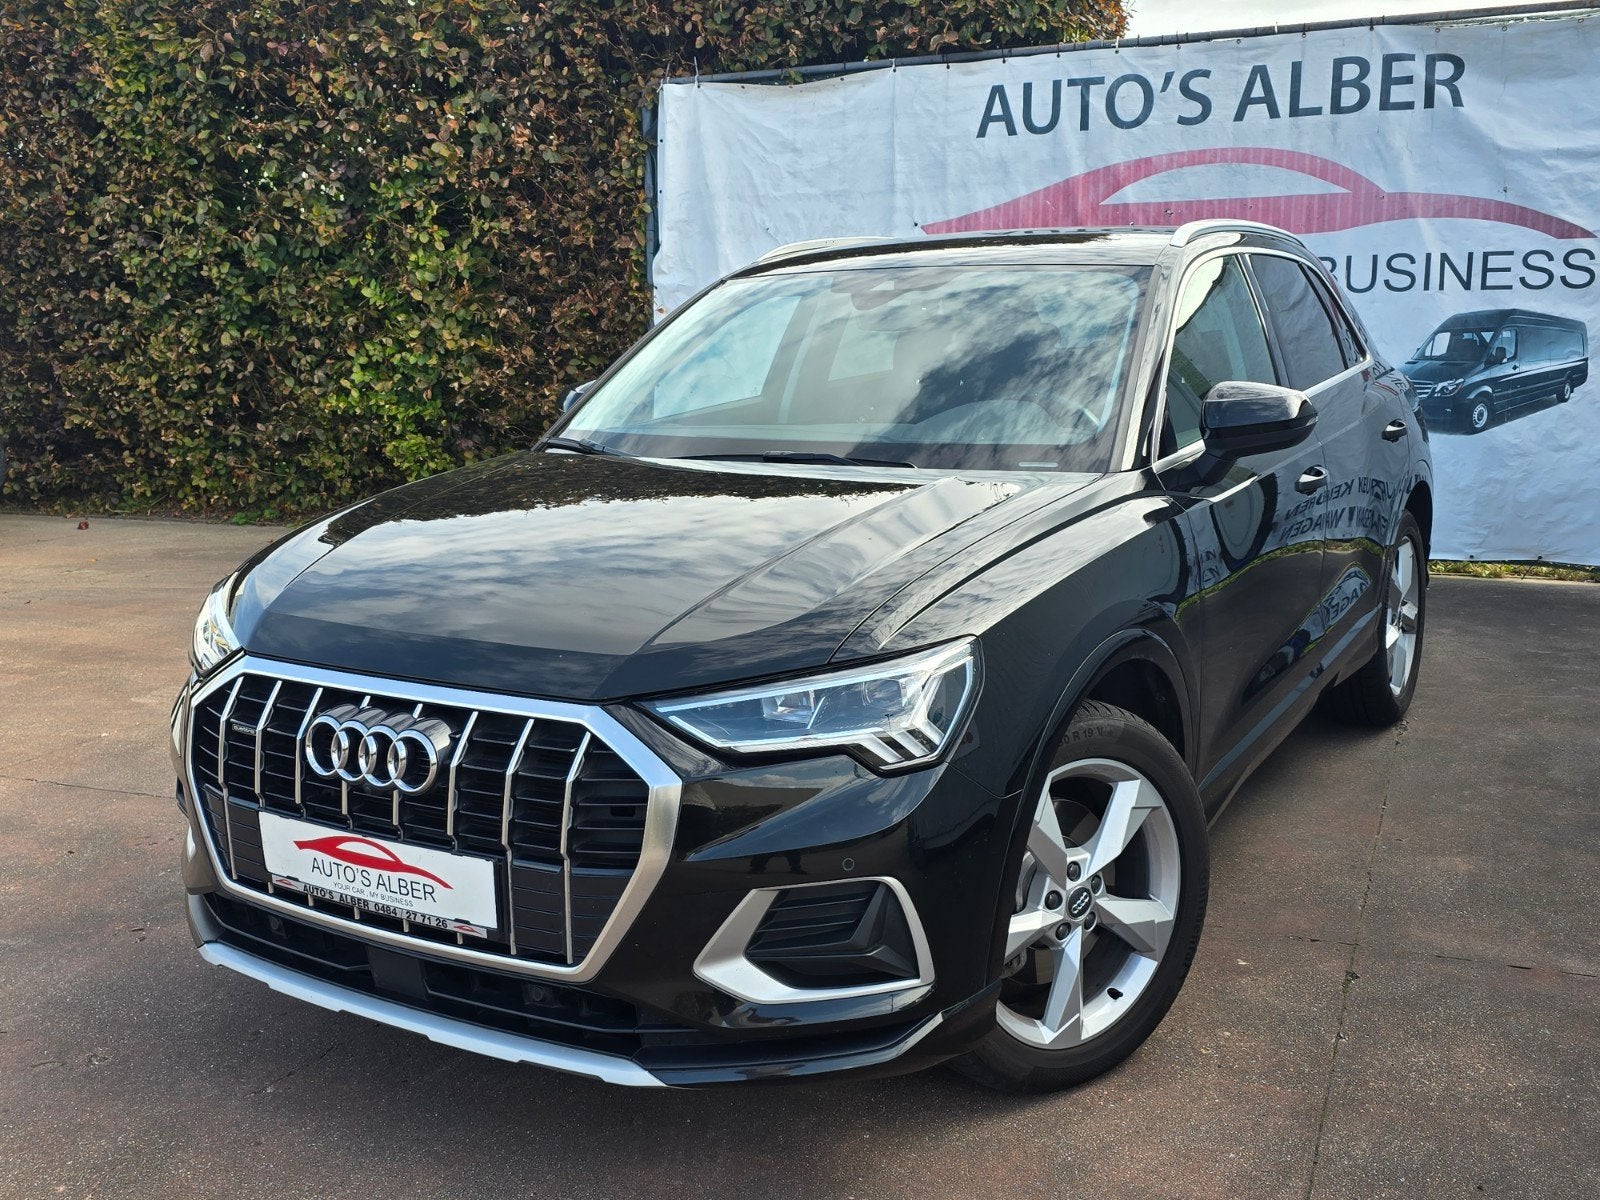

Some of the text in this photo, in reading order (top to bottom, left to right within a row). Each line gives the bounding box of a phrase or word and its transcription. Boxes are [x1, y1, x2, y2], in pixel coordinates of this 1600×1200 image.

[976, 53, 1467, 139] AUTO'S ALBER
[1083, 727, 1094, 739] 19
[311, 857, 437, 903] AUTO'S ALBER
[333, 881, 351, 893] YOUR
[369, 891, 379, 900] MY
[380, 893, 414, 908] BUSINESS
[303, 884, 335, 900] AUTO'S
[339, 895, 370, 911] ALBER
[374, 902, 398, 917] 0484
[405, 910, 417, 921] 27
[420, 913, 432, 925] 71
[435, 917, 448, 929] 26
